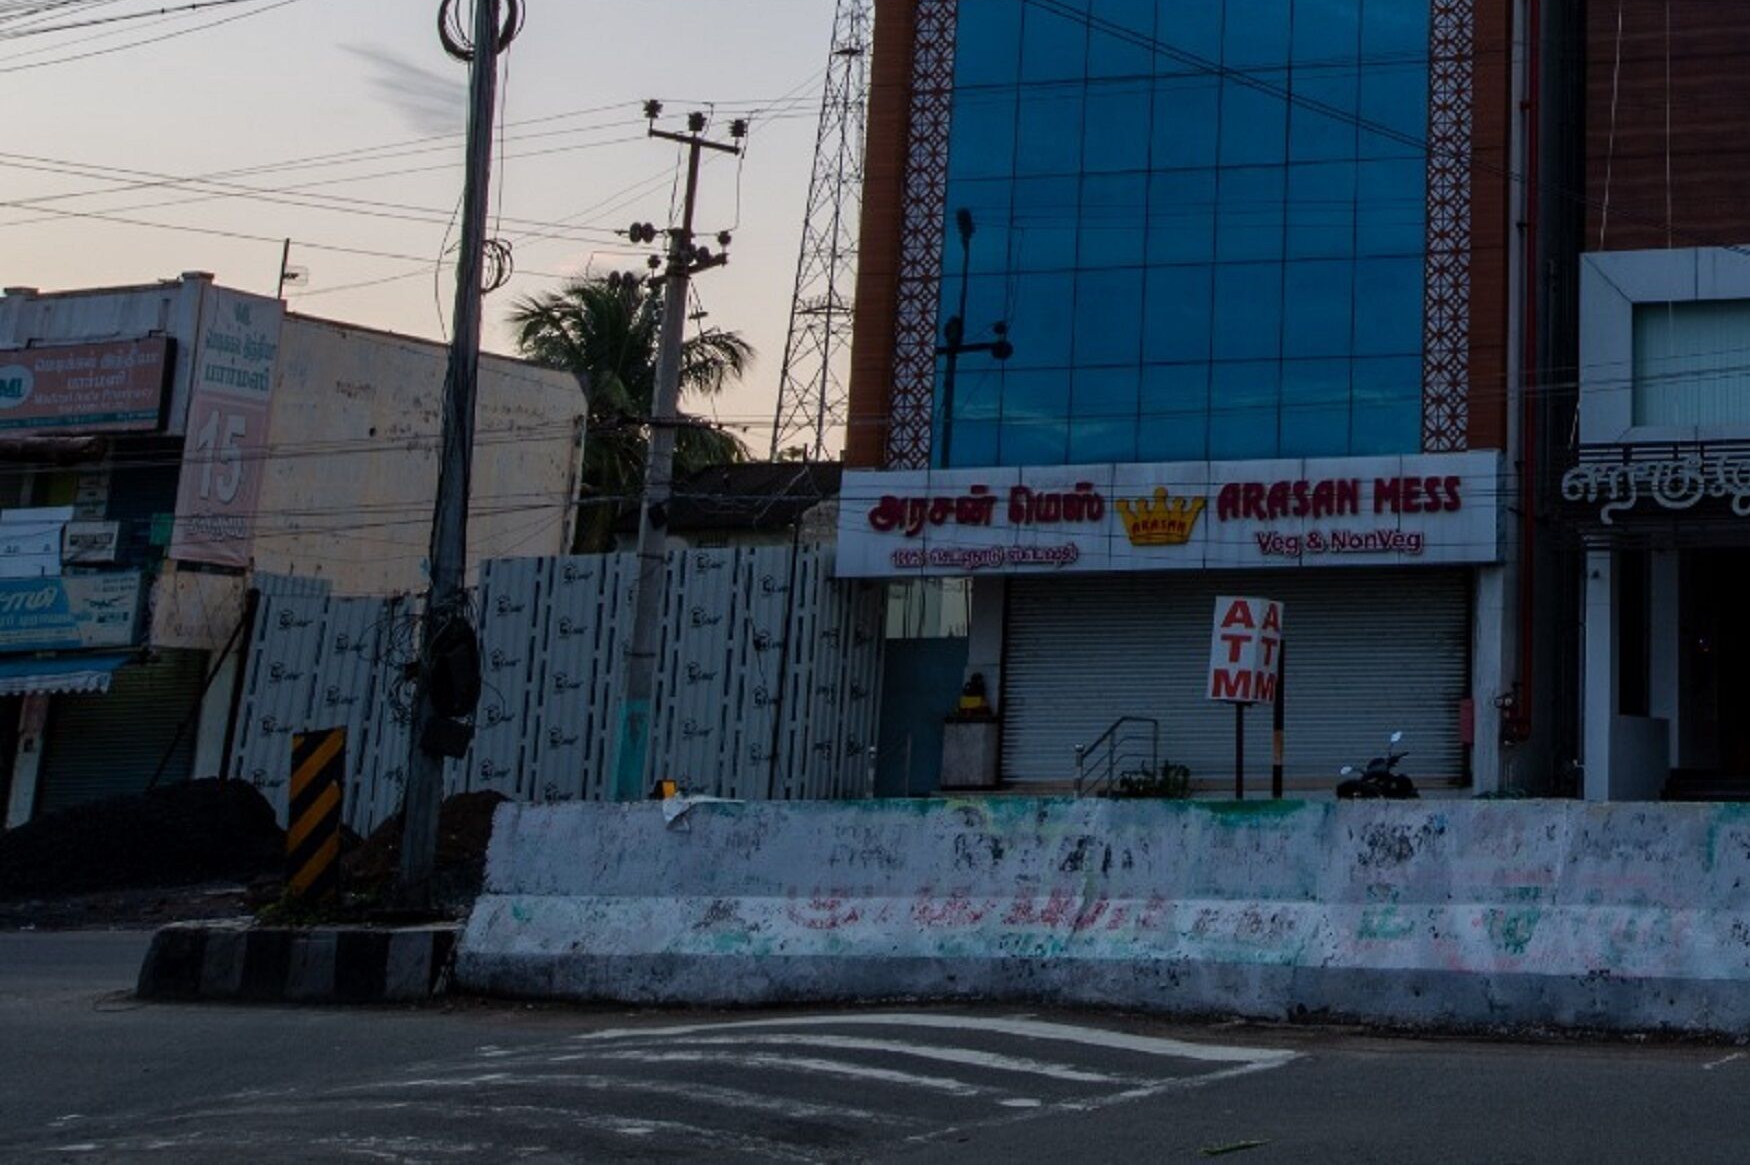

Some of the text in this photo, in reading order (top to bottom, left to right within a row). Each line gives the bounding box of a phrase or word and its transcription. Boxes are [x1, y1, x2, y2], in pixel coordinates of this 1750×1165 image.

[197, 408, 247, 504] 15
[869, 482, 1105, 537] அரசன் மெஸ்
[1217, 475, 1462, 522] ARASAN MESS
[1131, 520, 1188, 533] ARASAN
[1257, 531, 1301, 555] Veg
[1306, 531, 1327, 551] &
[1212, 600, 1255, 700] ATM
[1255, 603, 1280, 702] ATM
